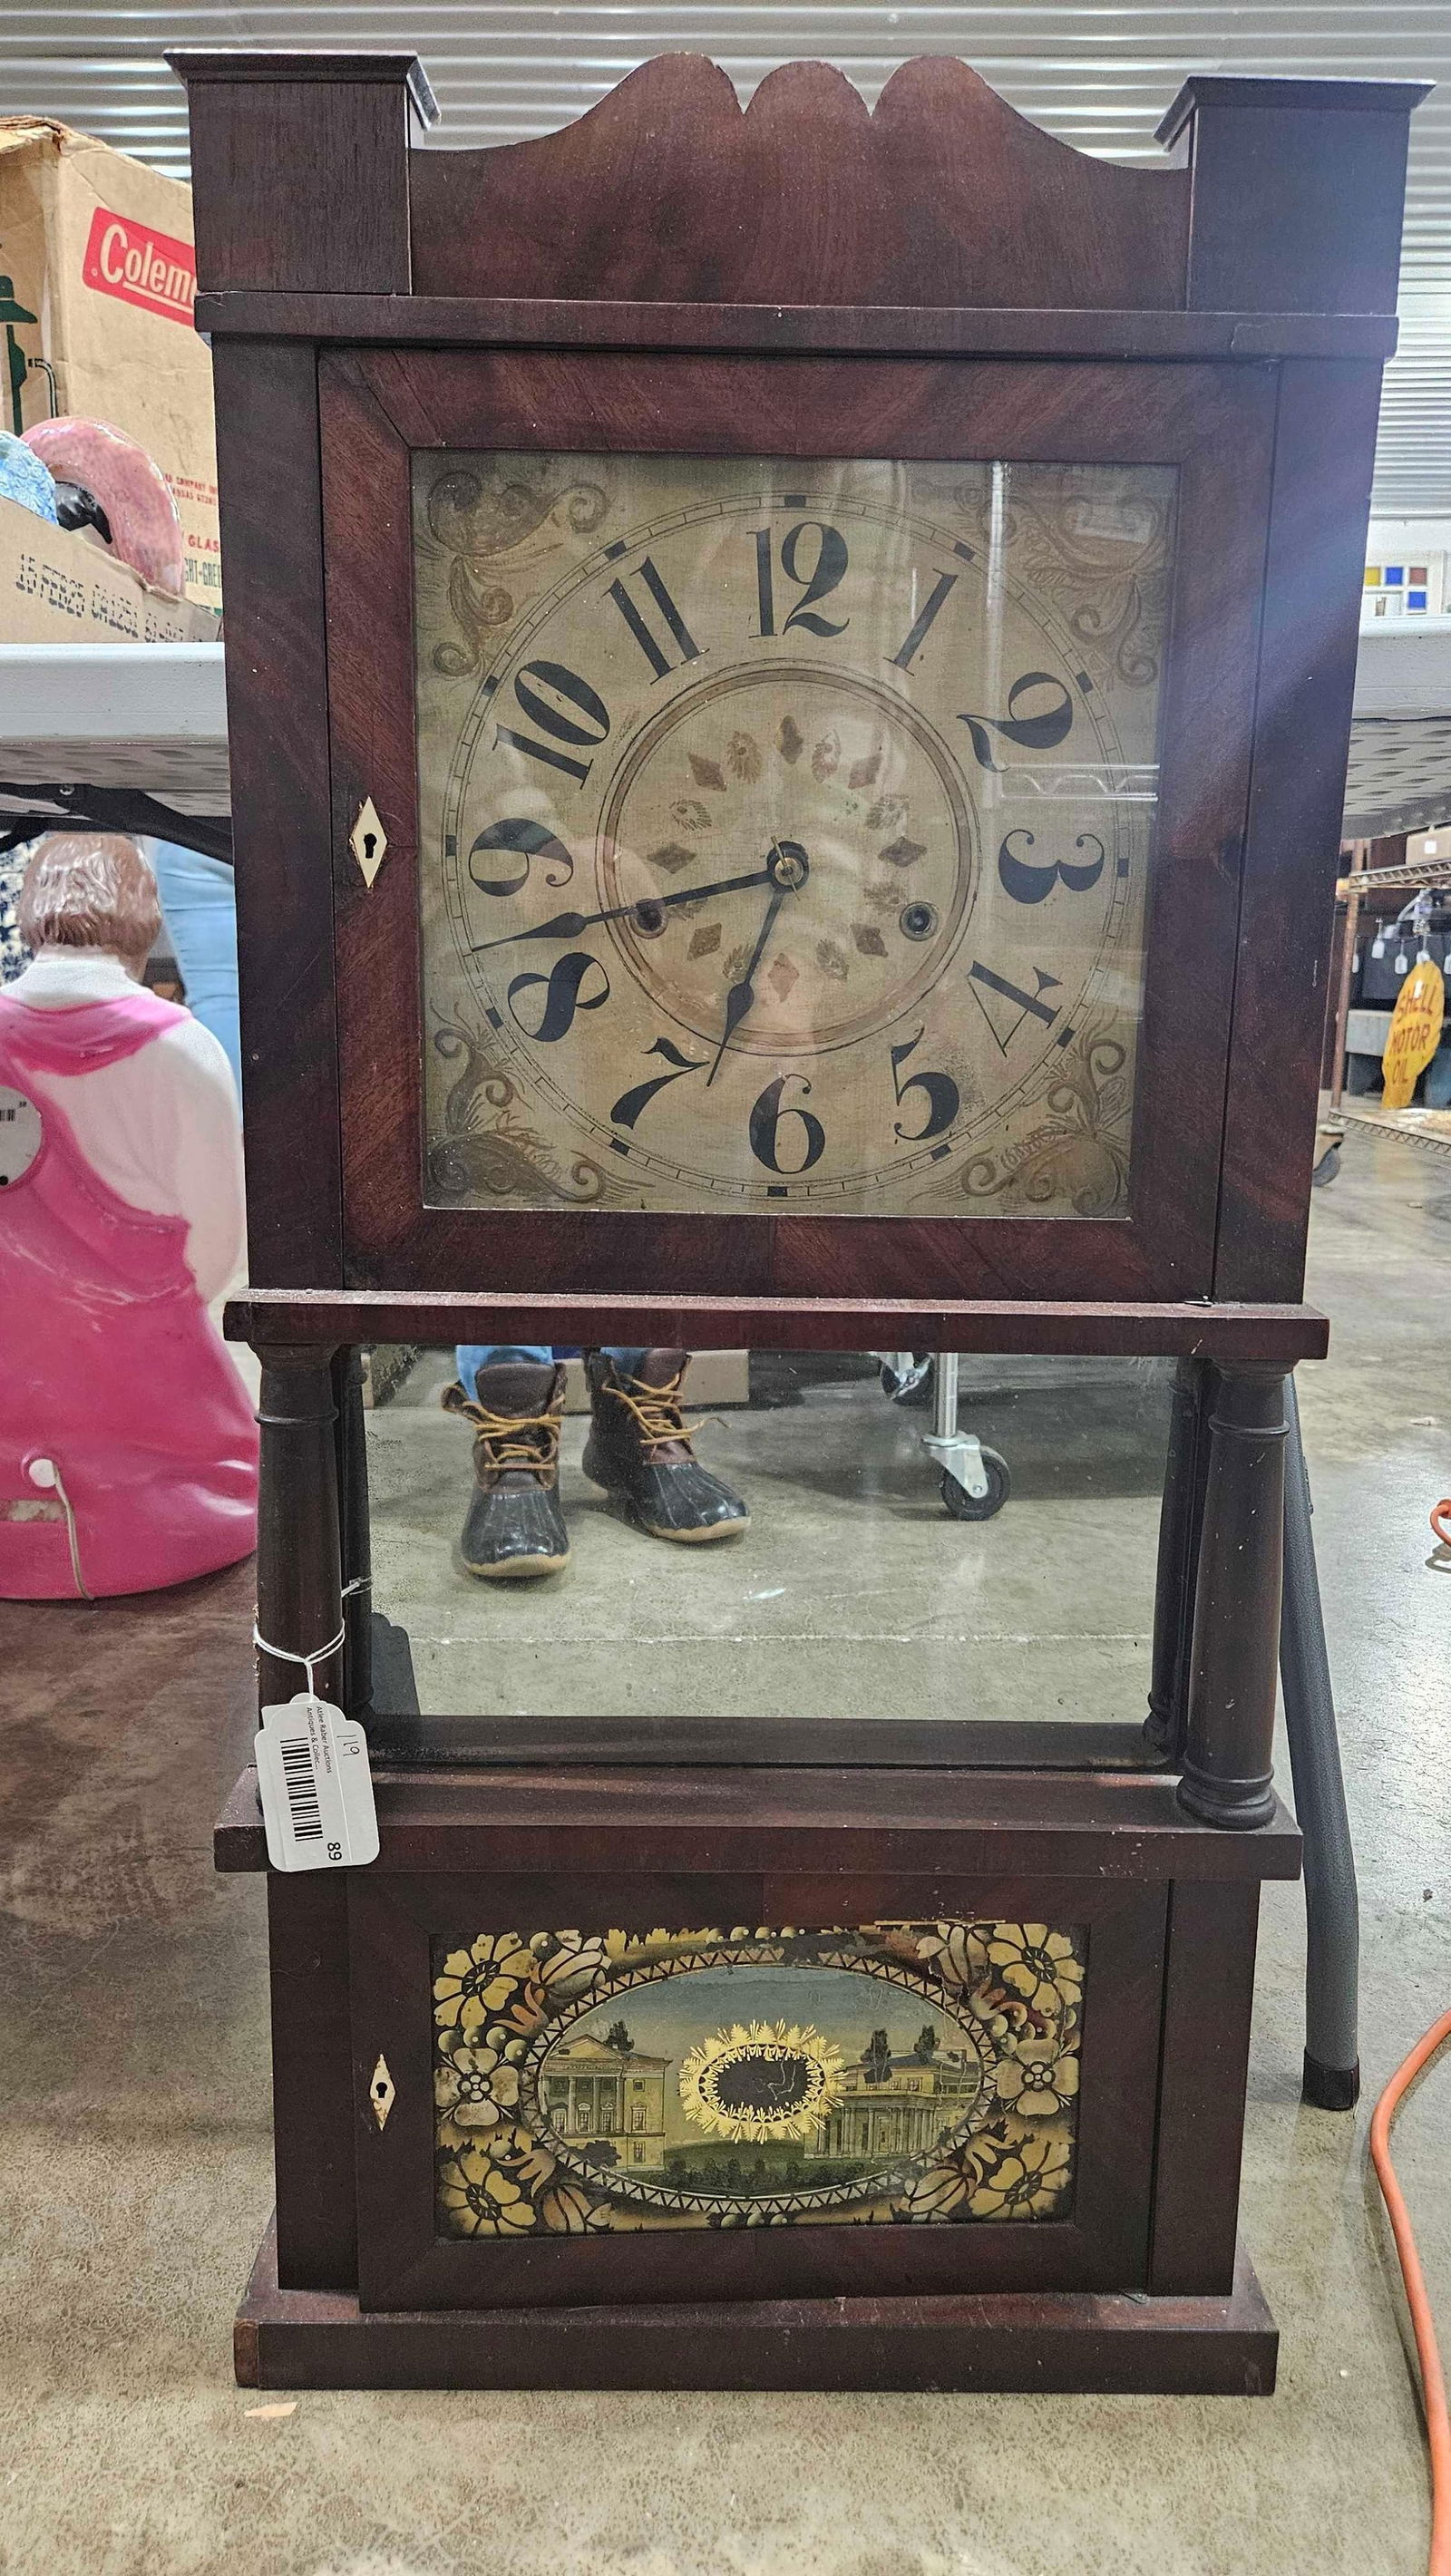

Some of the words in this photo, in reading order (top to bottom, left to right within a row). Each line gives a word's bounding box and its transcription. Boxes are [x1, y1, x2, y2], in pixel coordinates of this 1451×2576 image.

[172, 487, 194, 501] ANSAS
[188, 533, 219, 552] GLAS
[745, 521, 850, 639] 12
[603, 556, 710, 685] 11
[885, 568, 959, 676] 1
[492, 659, 611, 790] 10
[958, 670, 1076, 773] 2
[468, 817, 574, 899] 9
[998, 828, 1105, 905] 3
[508, 951, 611, 1044] 8
[968, 958, 1066, 1058] 4
[1397, 985, 1436, 1023] SHELL
[1389, 1023, 1430, 1055] MOTOR
[1392, 1057, 1408, 1085] OIL
[610, 1035, 710, 1129] 7
[891, 1026, 960, 1141] 5
[749, 1073, 825, 1176] 6
[306, 1706, 316, 1736] Antiques
[316, 1706, 325, 1724] Atlee
[319, 1724, 328, 1745] Raber
[336, 1734, 360, 1756] 119
[322, 1745, 333, 1774] Auctions
[327, 1842, 343, 1862] 89
